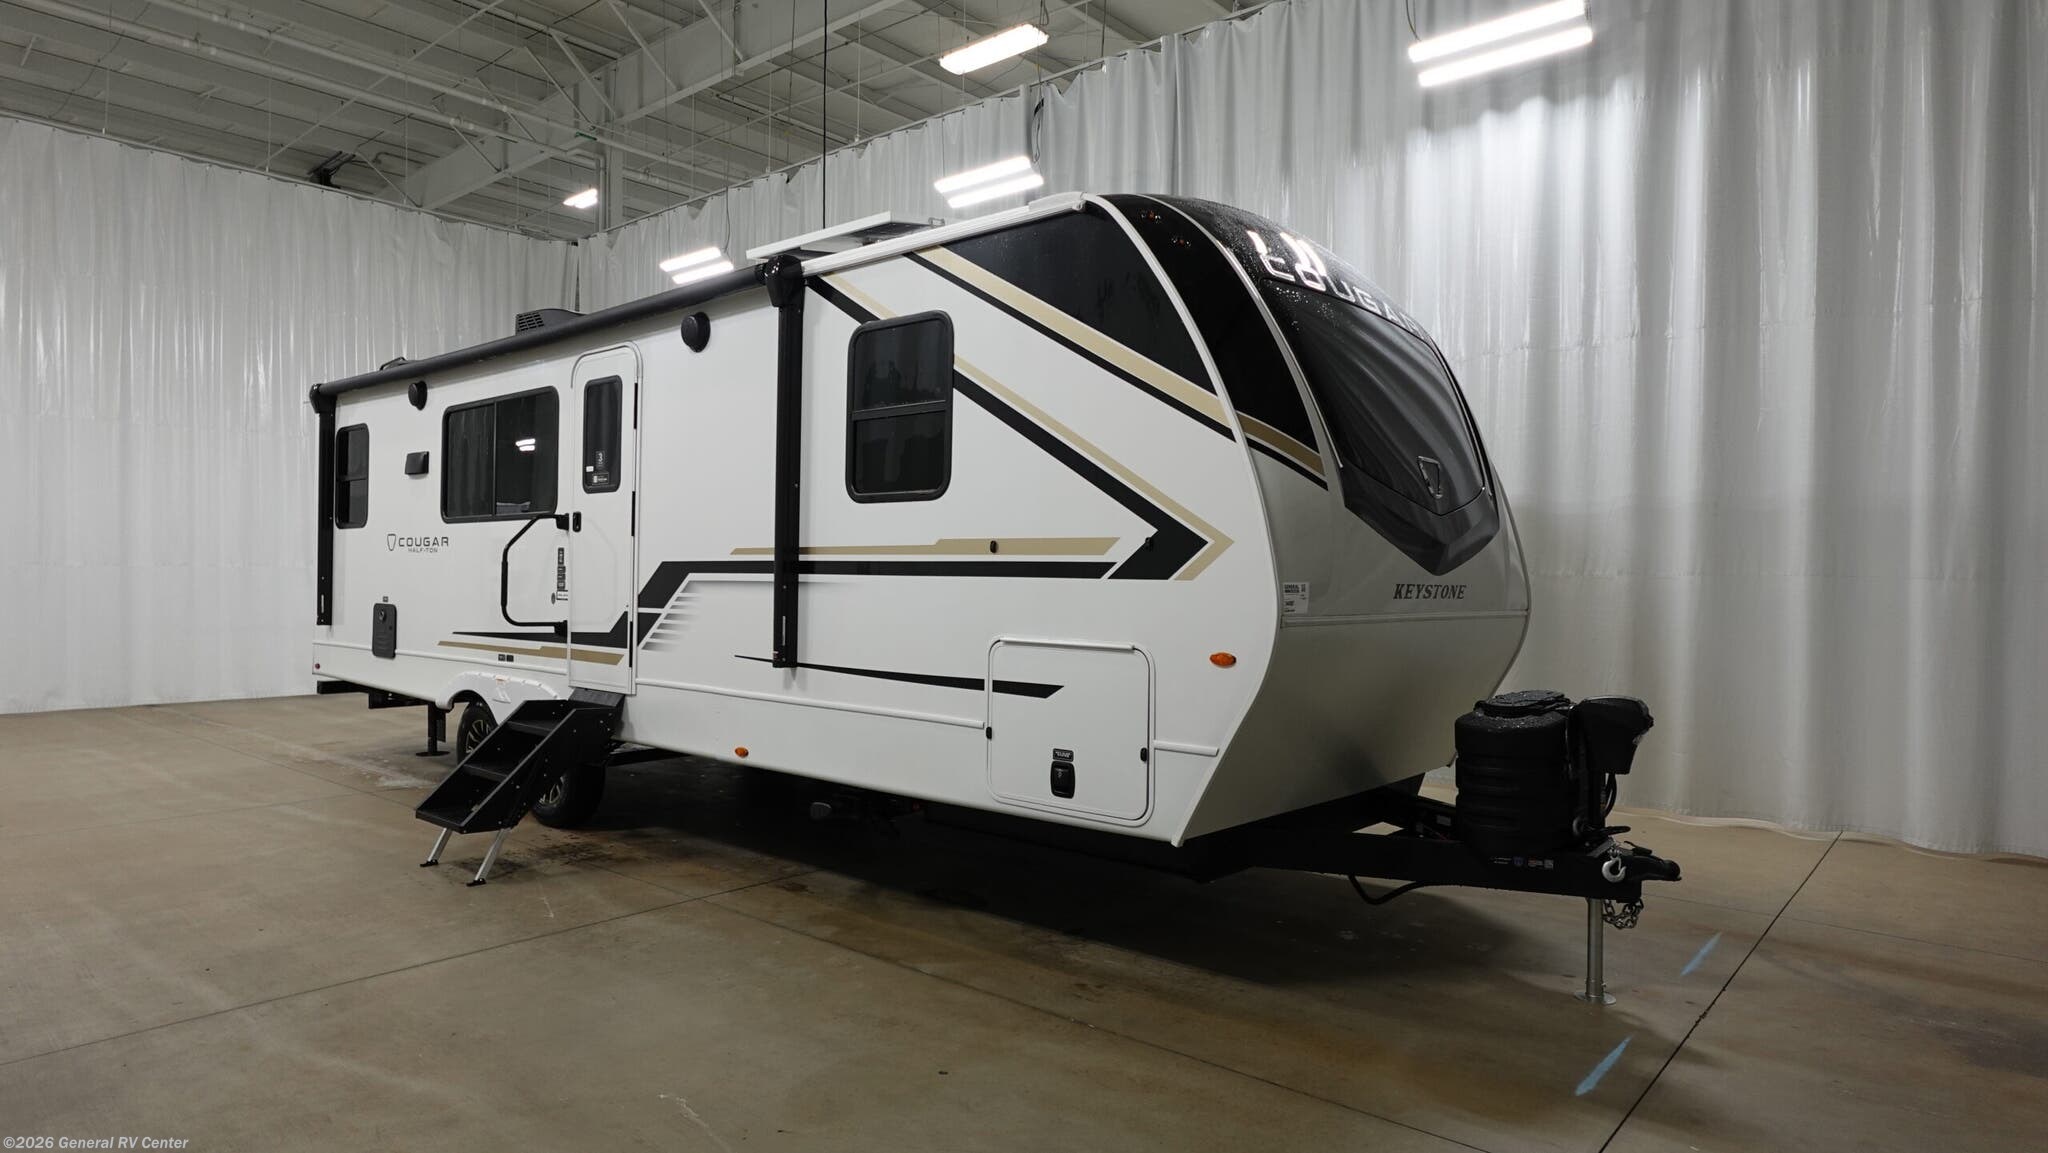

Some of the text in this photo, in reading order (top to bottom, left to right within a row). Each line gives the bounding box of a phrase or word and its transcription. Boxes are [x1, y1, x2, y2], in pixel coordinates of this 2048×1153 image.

[1259, 251, 1423, 334] COUGAR
[398, 536, 449, 547] COUGAR
[1393, 583, 1467, 600] KEYSTONE
